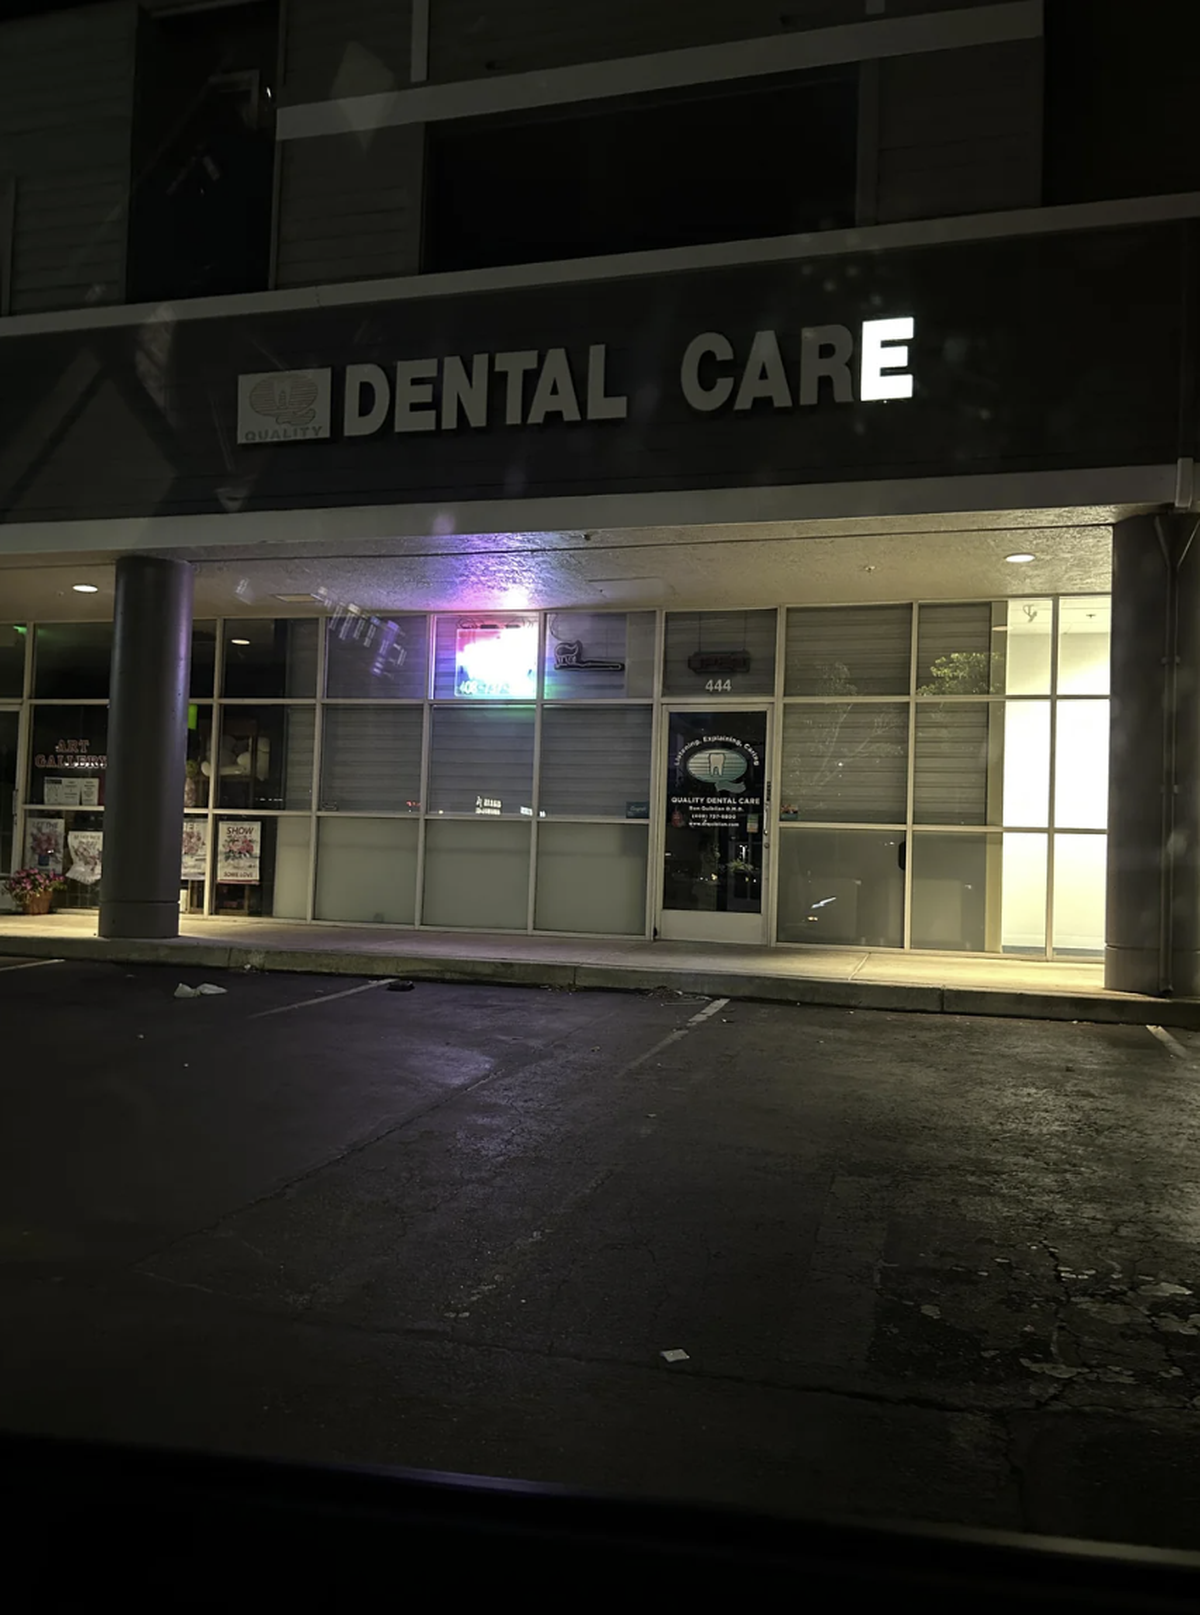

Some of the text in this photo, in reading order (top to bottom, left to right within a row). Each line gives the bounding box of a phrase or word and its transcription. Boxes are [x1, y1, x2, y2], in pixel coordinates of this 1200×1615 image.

[343, 317, 914, 437] DENTAL CARE
[245, 425, 323, 442] QUALITY
[705, 678, 732, 692] 444
[55, 739, 90, 753] ART
[34, 754, 107, 769] GALLERY
[743, 743, 760, 766] Caring
[738, 797, 761, 805] CARE
[226, 826, 254, 835] SHOW
